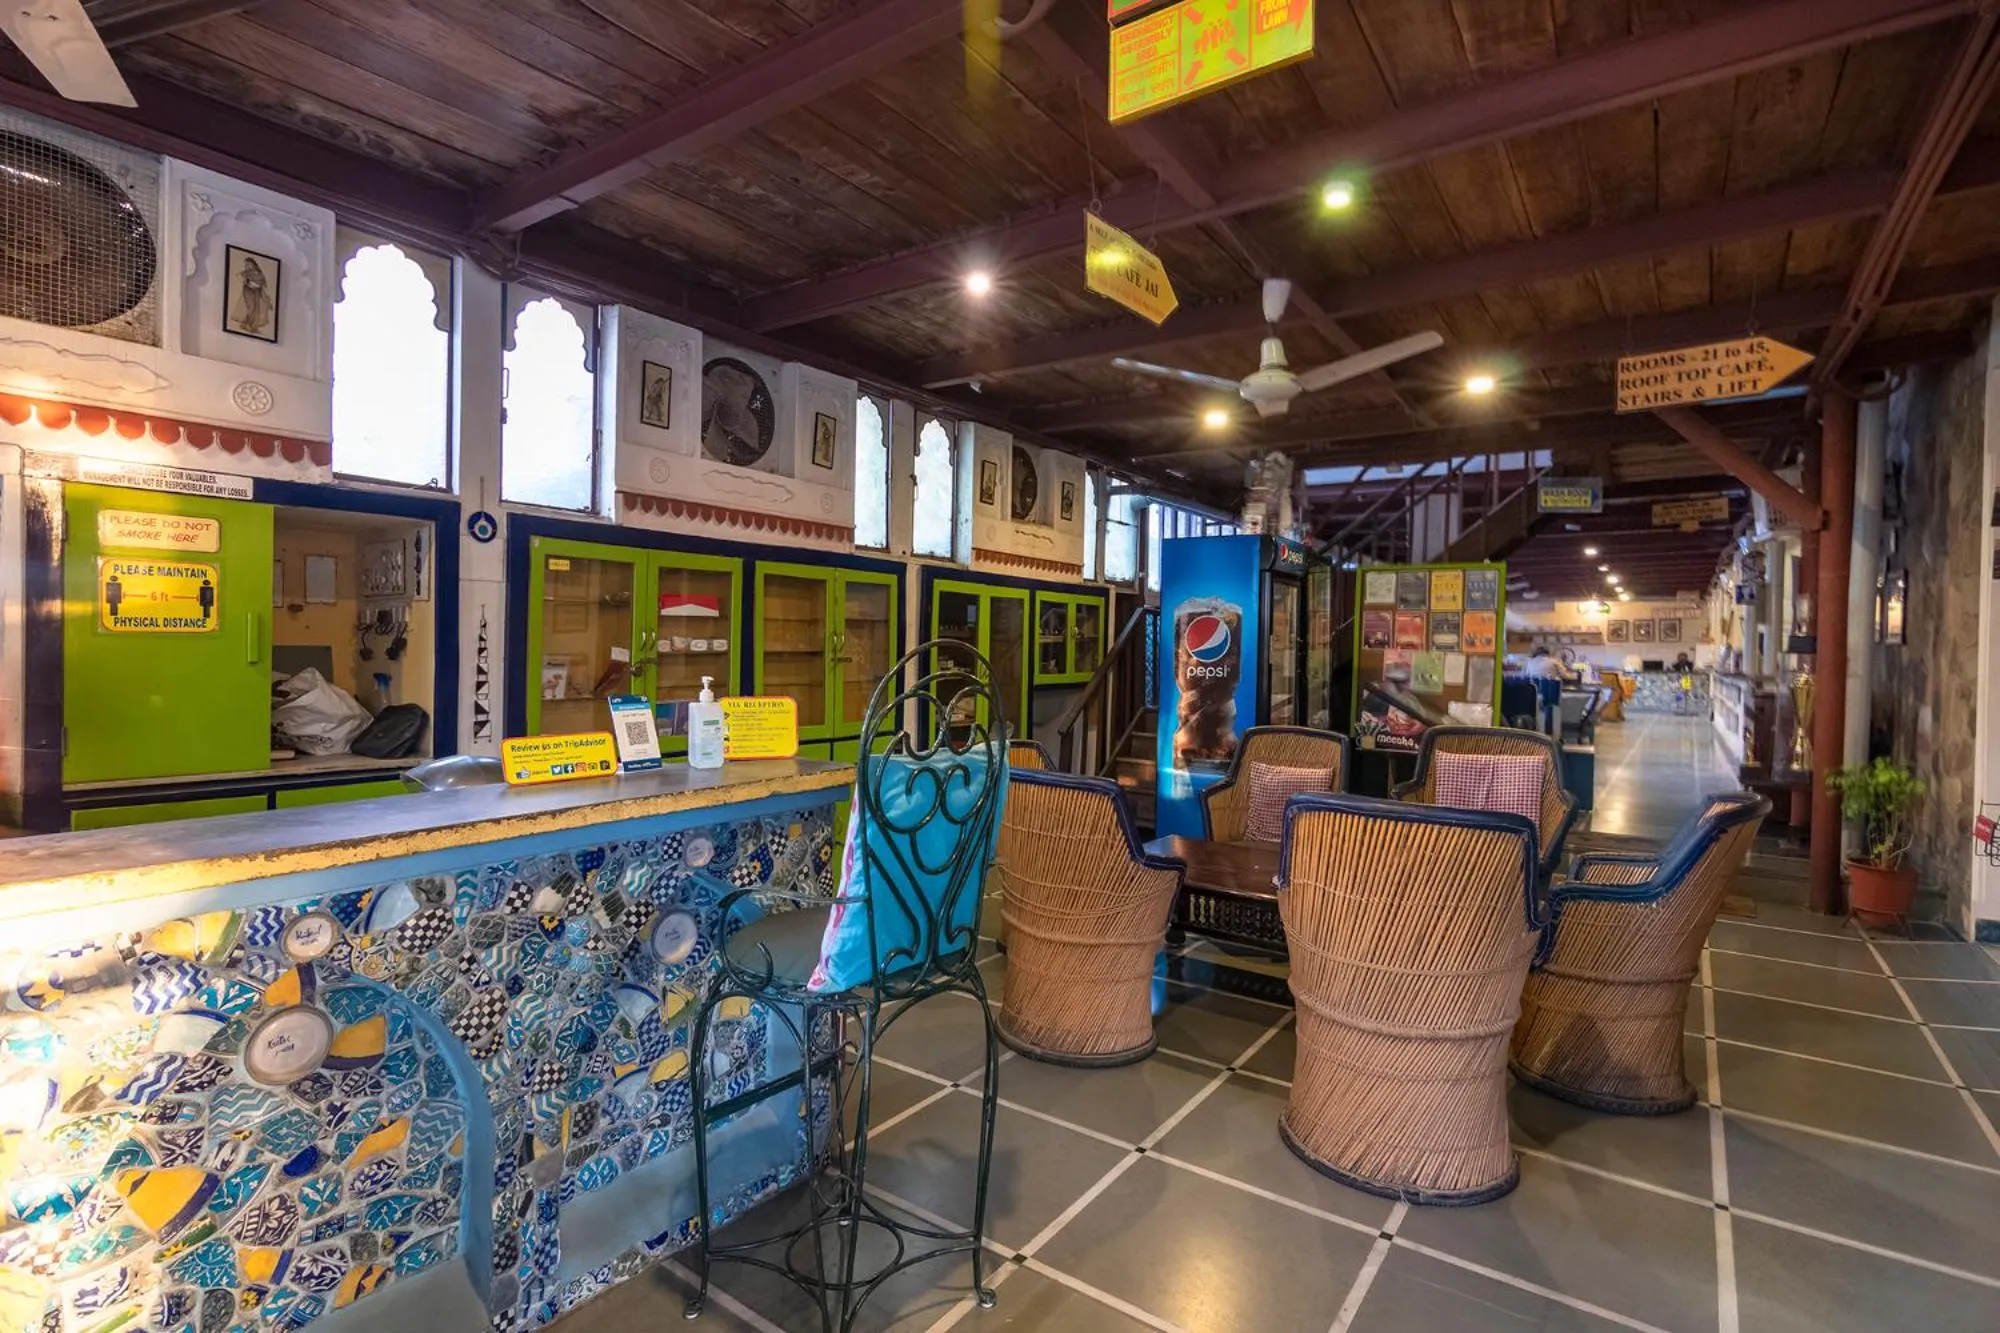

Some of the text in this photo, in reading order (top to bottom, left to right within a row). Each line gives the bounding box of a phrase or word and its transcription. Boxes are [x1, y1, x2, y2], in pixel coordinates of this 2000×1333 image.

[1620, 353, 1686, 374] ROOMS
[1701, 347, 1719, 361] 21
[1724, 346, 1741, 358] to
[1620, 374, 1670, 392] ROOF
[1676, 367, 1712, 384] TOP
[1619, 378, 1763, 408] STAIRS & LIFT
[168, 470, 184, 480] YOUR
[142, 478, 154, 488] NOT
[155, 479, 163, 488] BE
[164, 480, 202, 493] RESPONSIBLE
[203, 485, 214, 493] FOR
[215, 486, 226, 495] ANY
[110, 515, 213, 531] PLEASE DO NOT
[117, 529, 200, 543] SMOKE HERE
[113, 564, 208, 579] PLEASE MAINTAIN
[150, 592, 169, 602] 6 ft
[114, 616, 207, 629] PHYSICAL DISTANCE
[1187, 665, 1228, 680] pepsi
[511, 737, 606, 753] Review us on TripAdvisor
